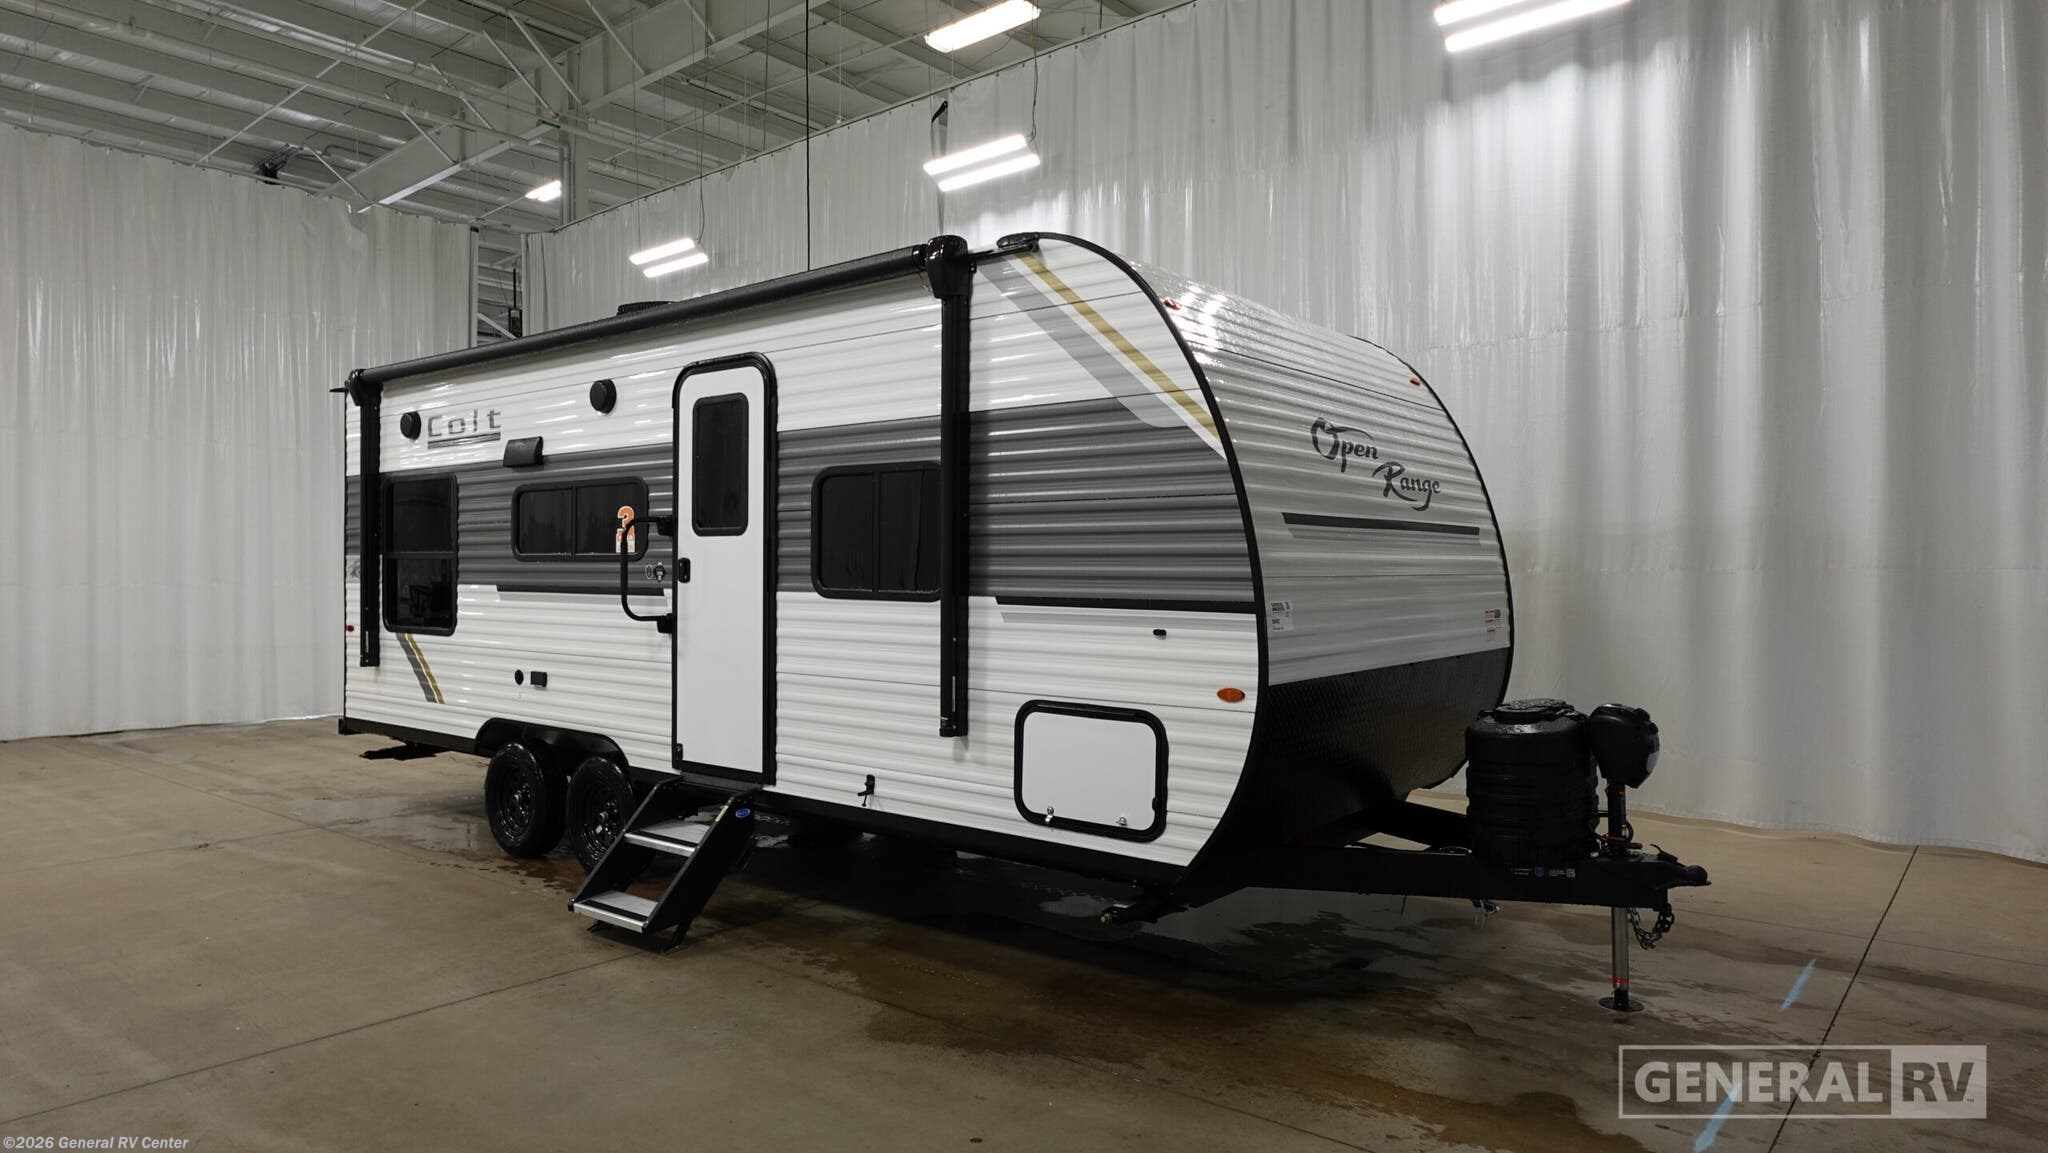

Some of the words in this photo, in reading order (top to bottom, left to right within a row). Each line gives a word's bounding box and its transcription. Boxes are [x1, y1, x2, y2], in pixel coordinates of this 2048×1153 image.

[427, 409, 502, 437] Colt
[1311, 417, 1378, 473] Open
[1371, 461, 1441, 511] Range
